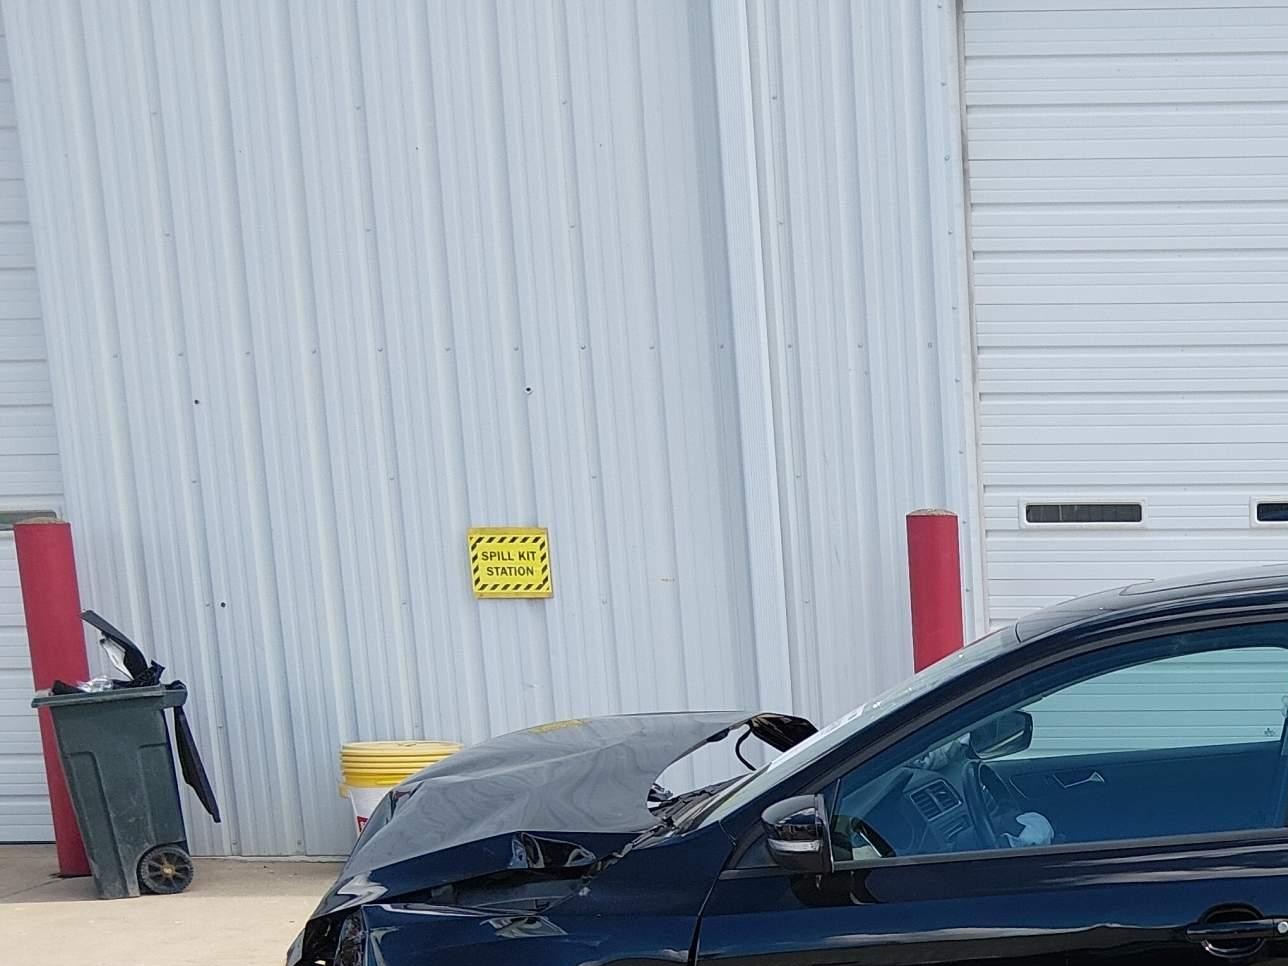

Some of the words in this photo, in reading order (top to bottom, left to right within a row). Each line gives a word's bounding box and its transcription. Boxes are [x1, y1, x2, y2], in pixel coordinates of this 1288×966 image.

[481, 551, 515, 561] SPILL
[518, 551, 537, 561] KIT
[486, 566, 534, 577] STATION
